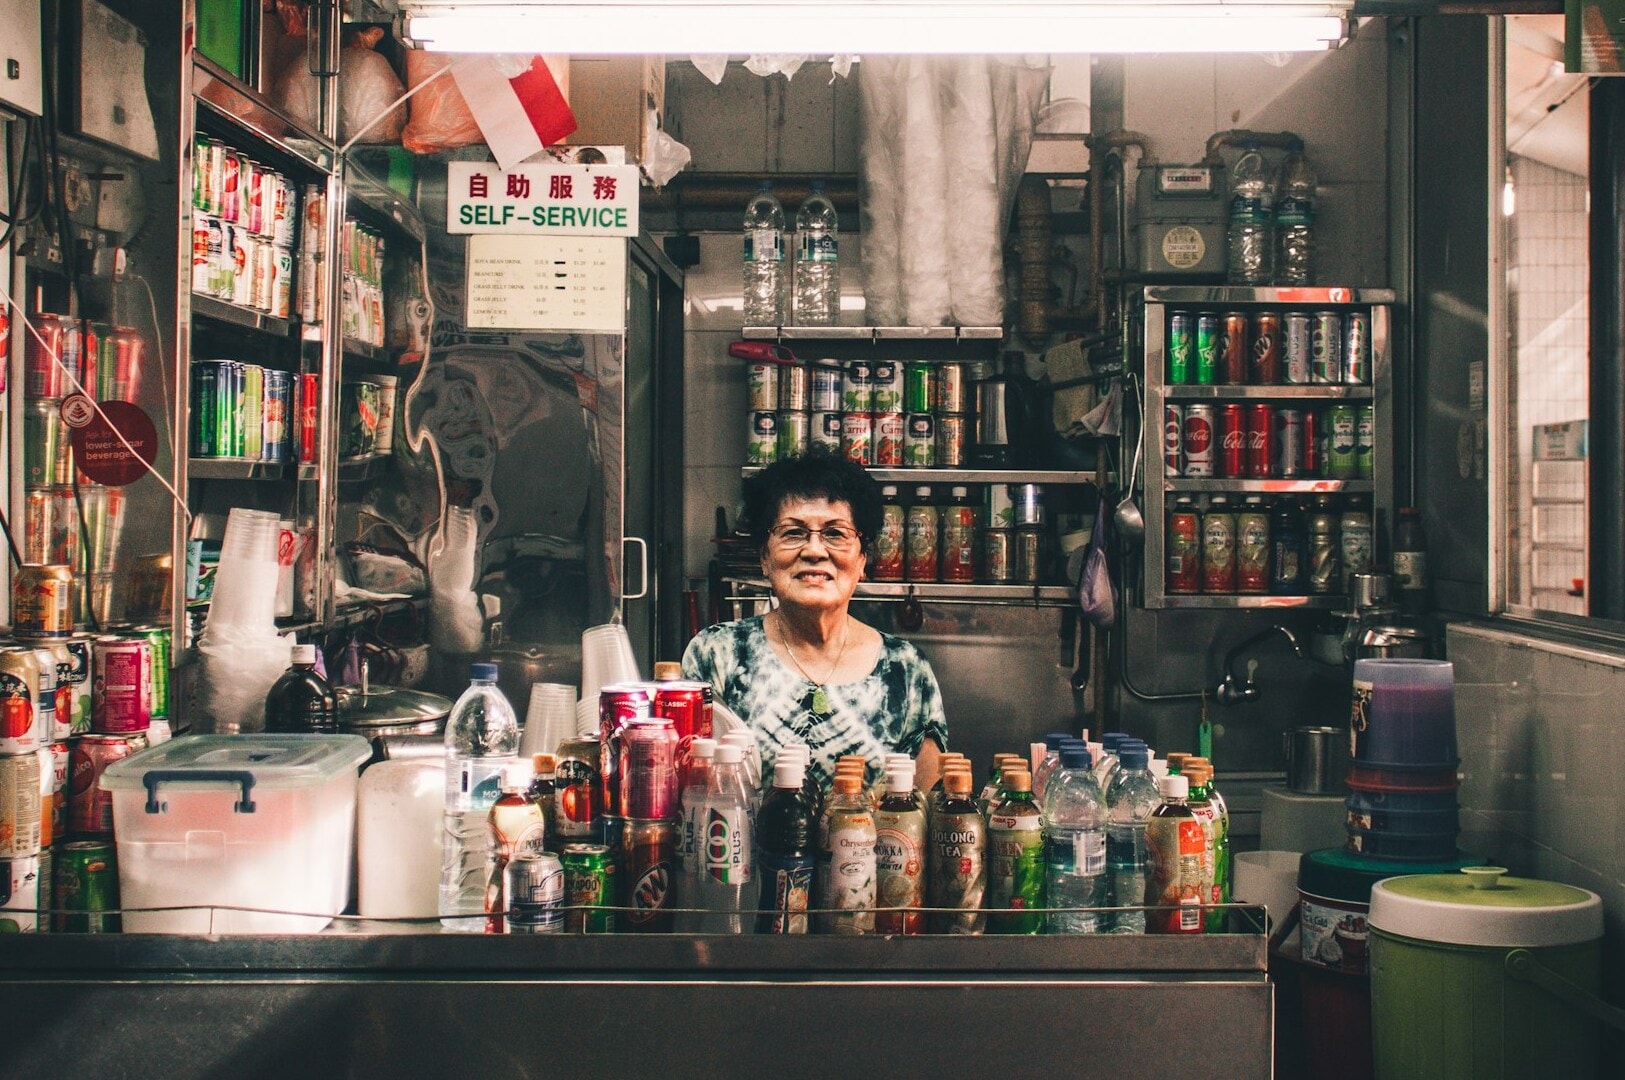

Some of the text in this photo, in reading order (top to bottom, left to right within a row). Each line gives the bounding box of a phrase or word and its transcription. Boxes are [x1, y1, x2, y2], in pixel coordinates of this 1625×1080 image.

[469, 172, 617, 200] 自助服務
[459, 204, 628, 227] SELF-SERVICE
[85, 440, 144, 450] lower-sugar
[85, 451, 137, 461] beverages
[706, 820, 731, 871] 100
[931, 829, 975, 844] OOLONG
[732, 830, 741, 864] PLUS
[939, 844, 962, 857] TEA
